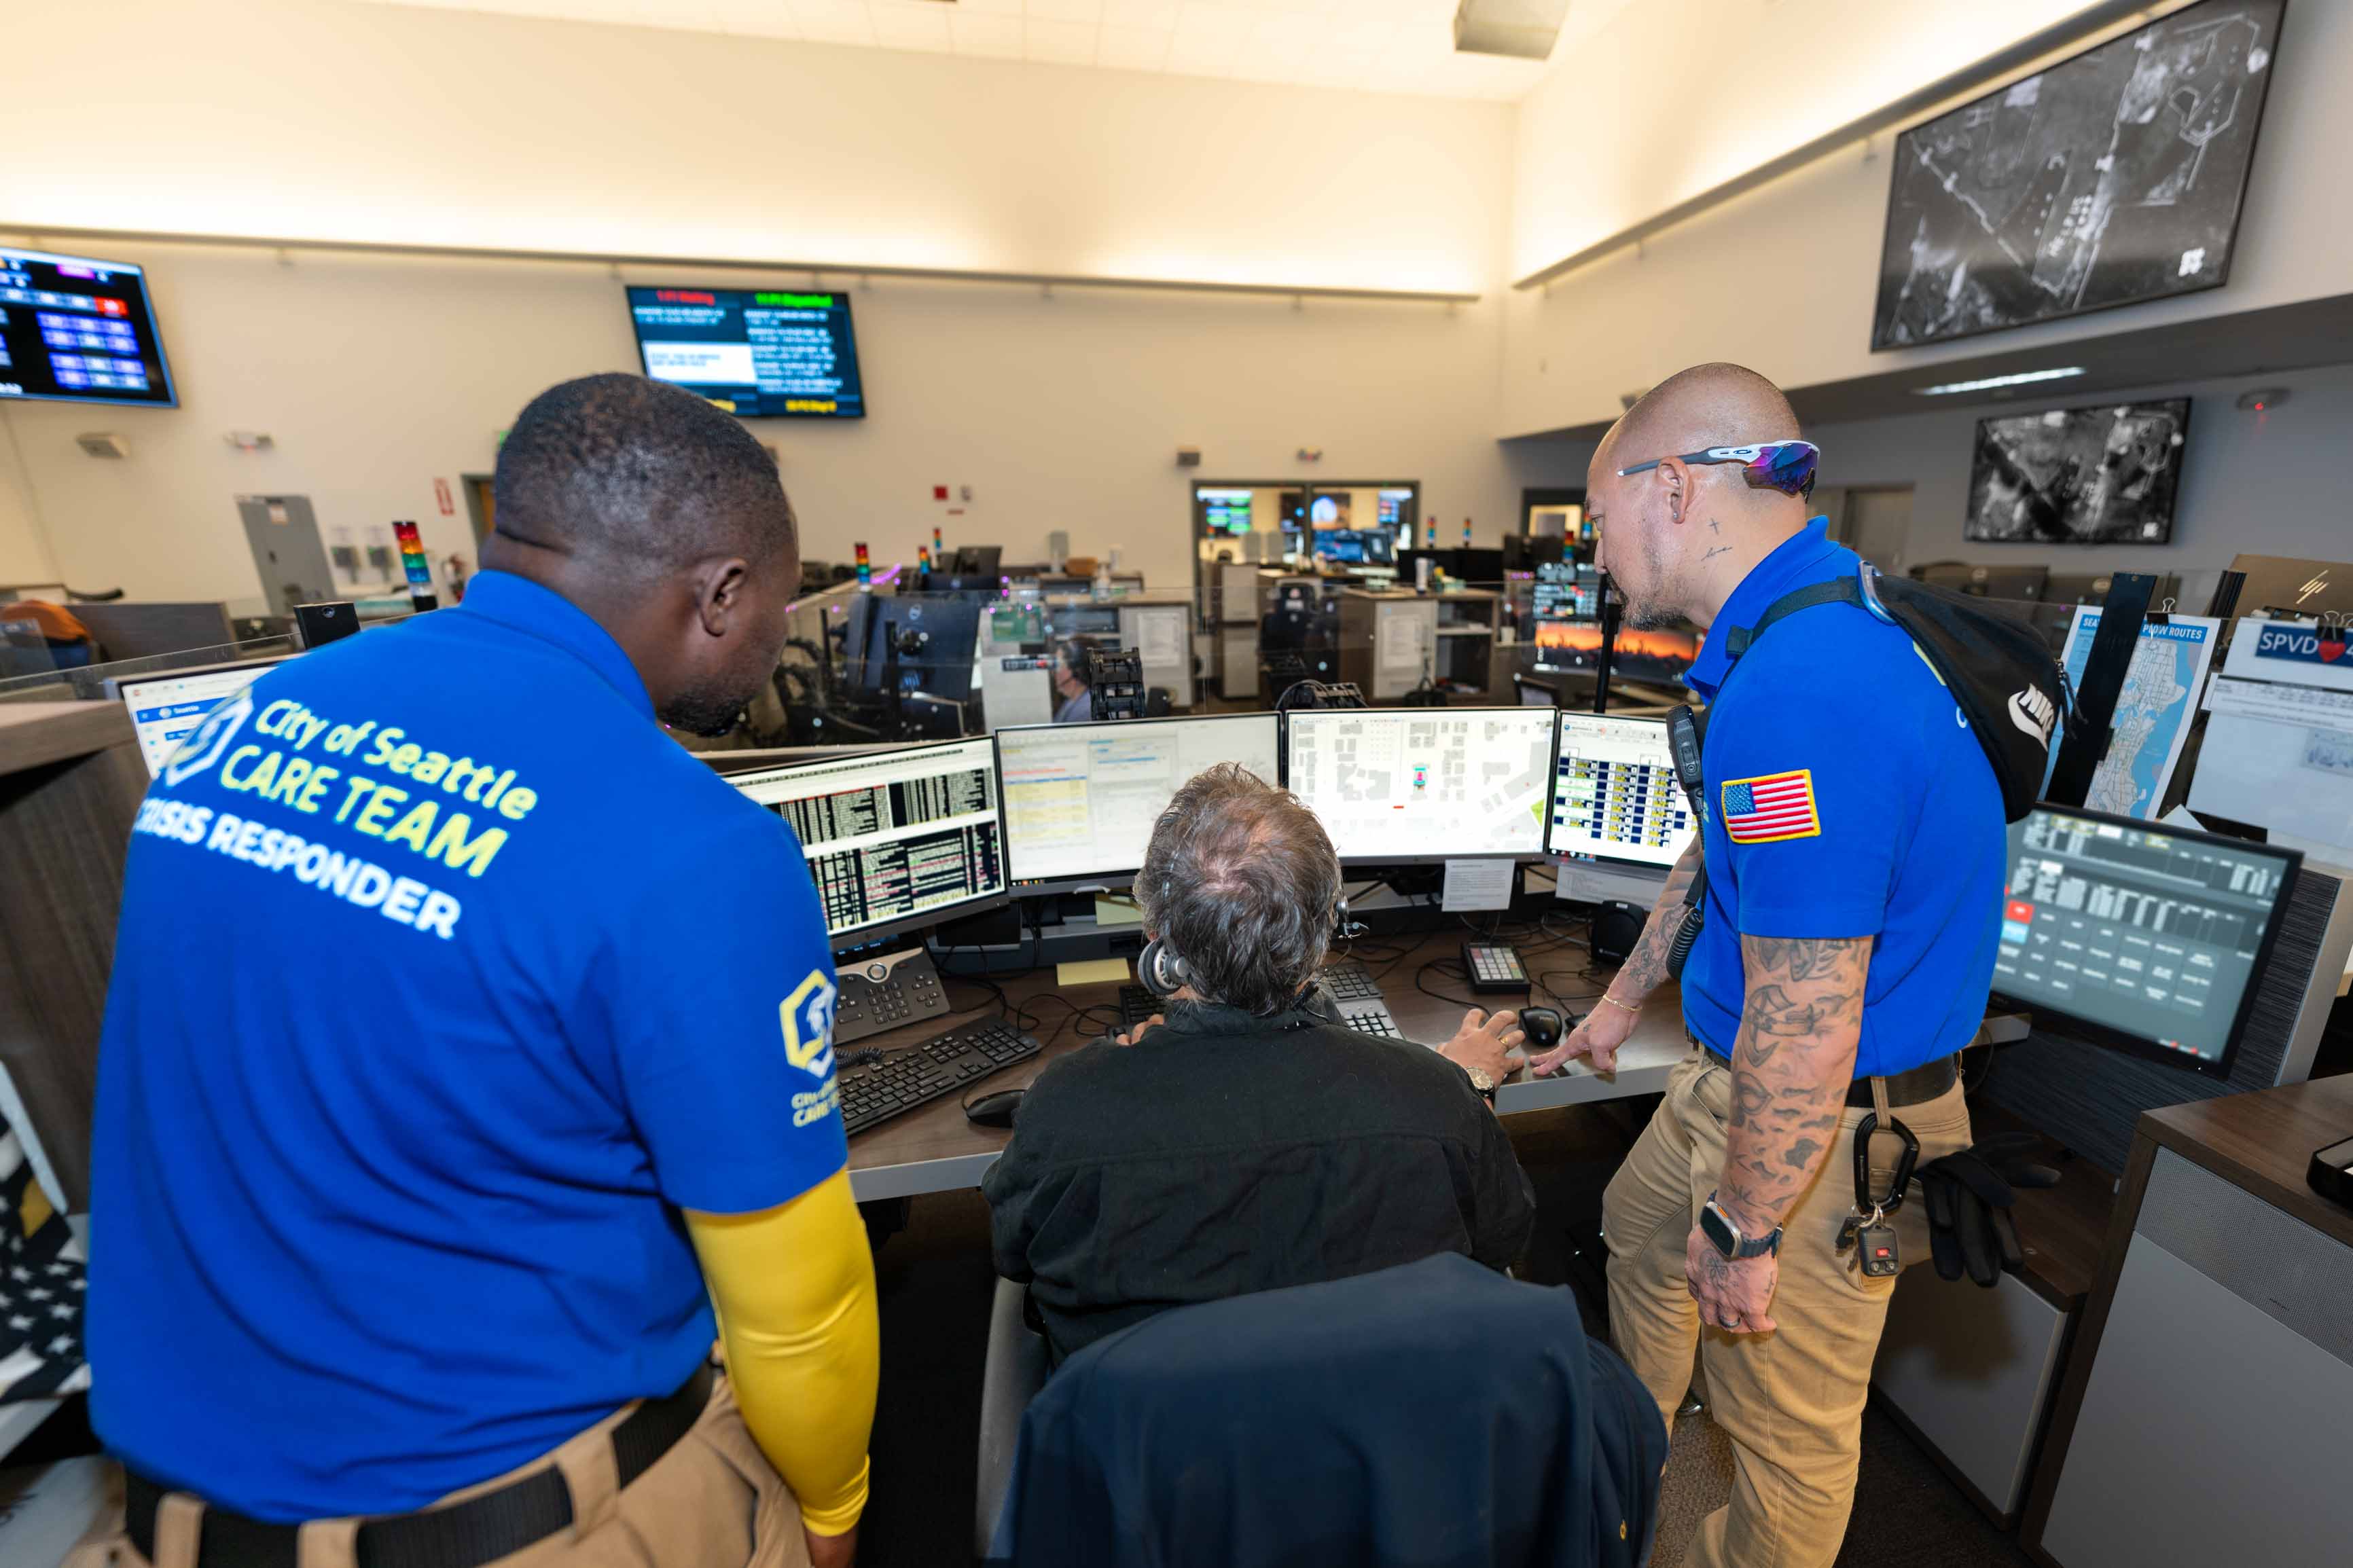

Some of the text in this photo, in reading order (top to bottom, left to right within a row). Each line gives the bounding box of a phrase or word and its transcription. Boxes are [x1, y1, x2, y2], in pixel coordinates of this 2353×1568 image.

[2169, 626, 2203, 640] ROUTES
[2259, 632, 2320, 655] SPVD
[220, 744, 509, 877] CARE TEAM
[255, 699, 538, 820] City of Seattle
[205, 812, 463, 940] RESPONDER
